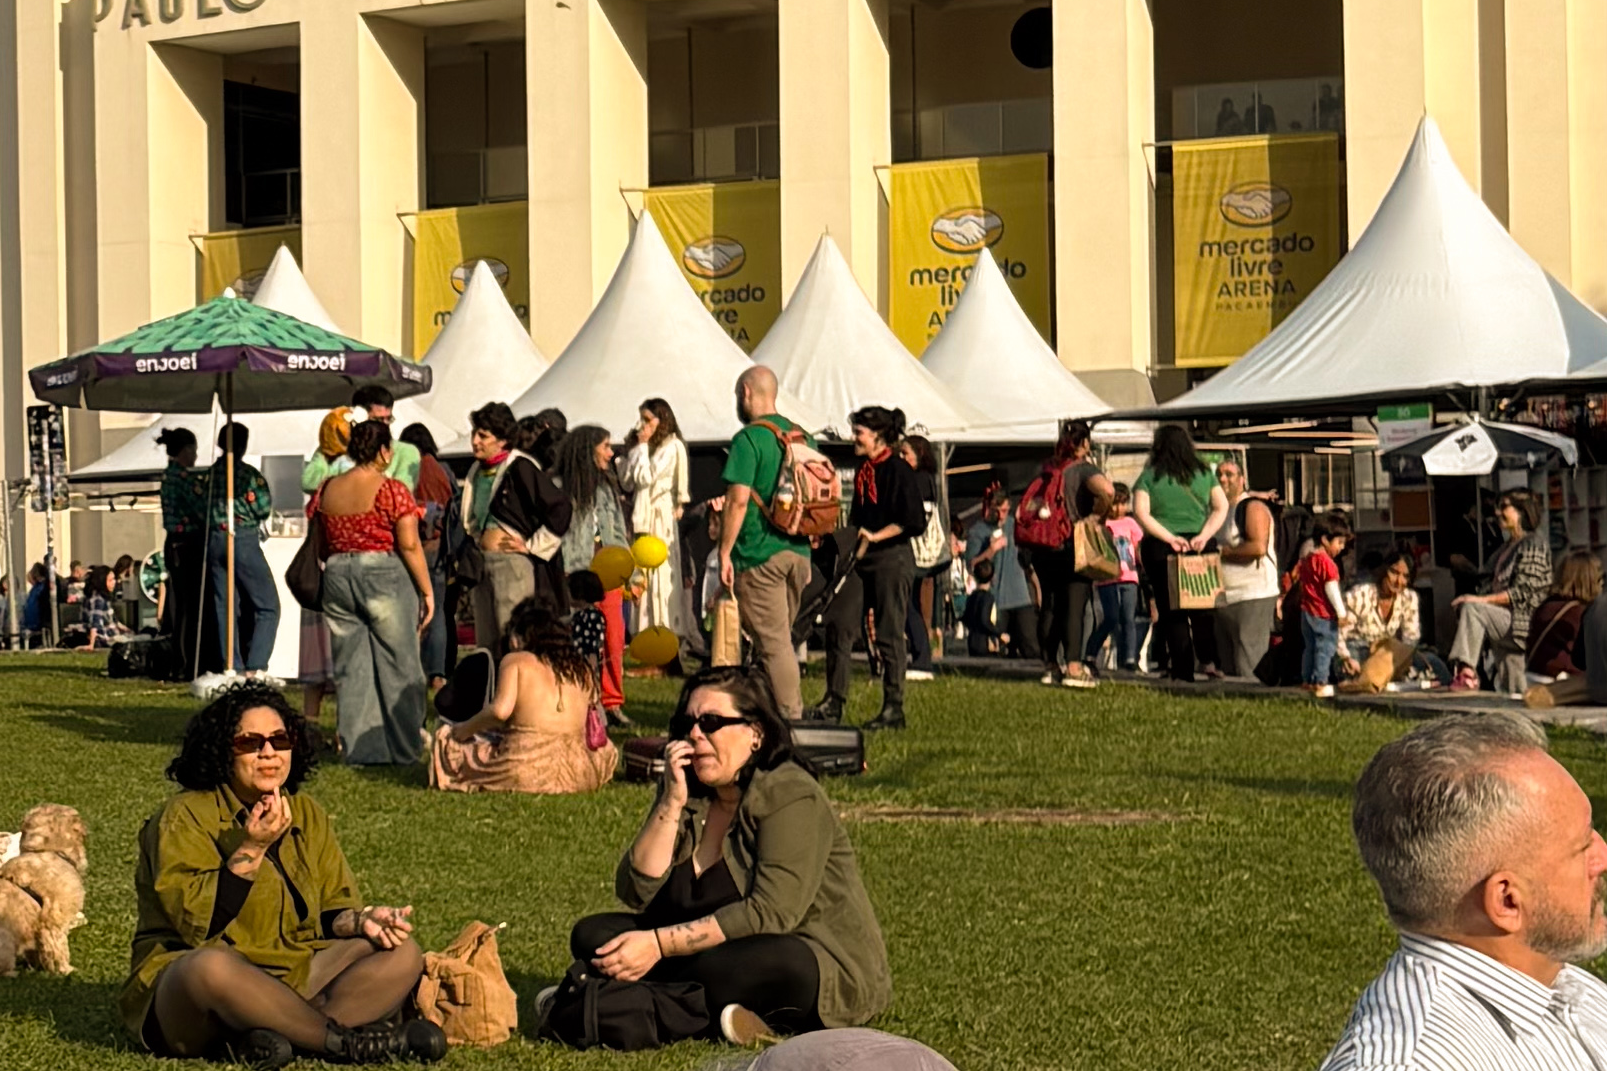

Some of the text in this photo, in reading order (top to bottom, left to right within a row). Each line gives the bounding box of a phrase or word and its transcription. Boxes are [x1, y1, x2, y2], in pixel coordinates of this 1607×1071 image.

[1199, 232, 1315, 258] mercado
[1230, 256, 1283, 278] livre
[1217, 279, 1296, 299] ARENA
[135, 353, 197, 373] enjoei
[287, 353, 346, 371] enjoei
